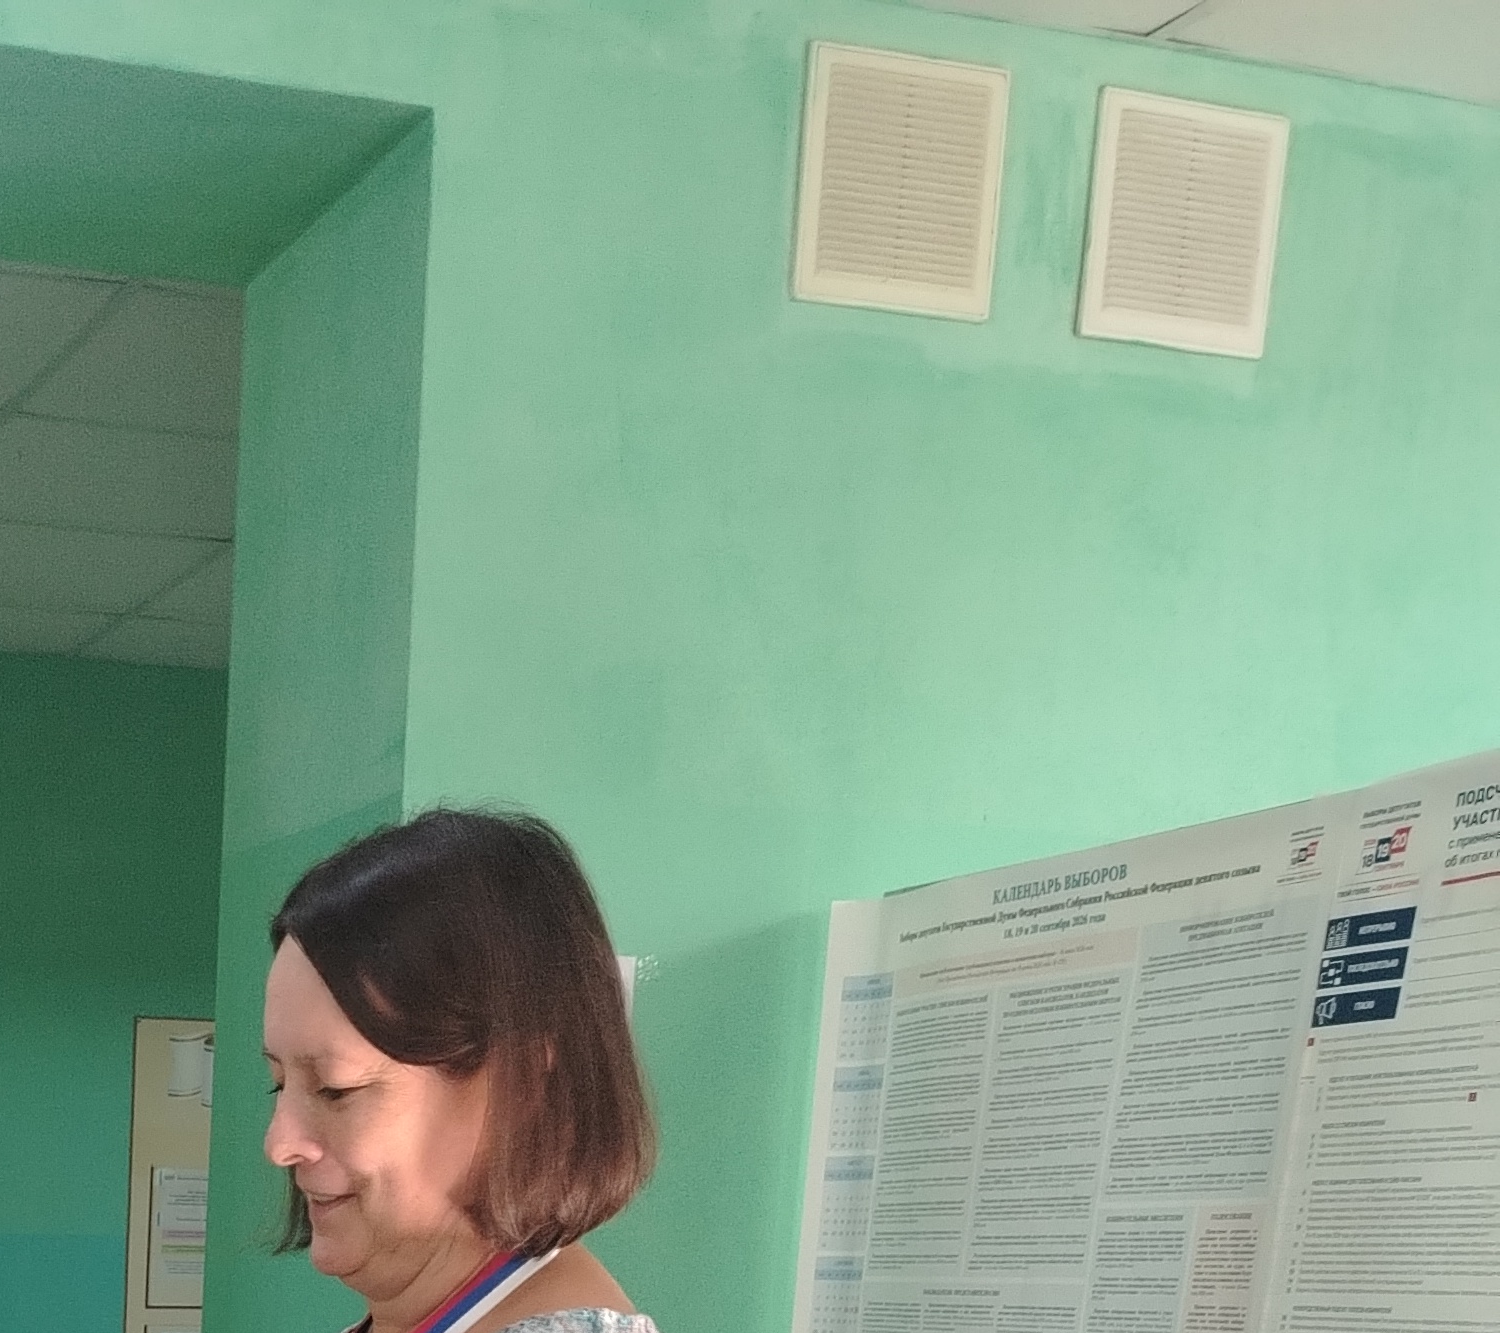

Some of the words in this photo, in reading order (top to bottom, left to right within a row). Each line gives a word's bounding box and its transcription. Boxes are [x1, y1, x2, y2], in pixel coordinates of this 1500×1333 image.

[1391, 832, 1407, 849] 20
[992, 876, 1063, 905] КАЛЕНДАРЬ
[1063, 864, 1128, 892] ВЫБОРОВ
